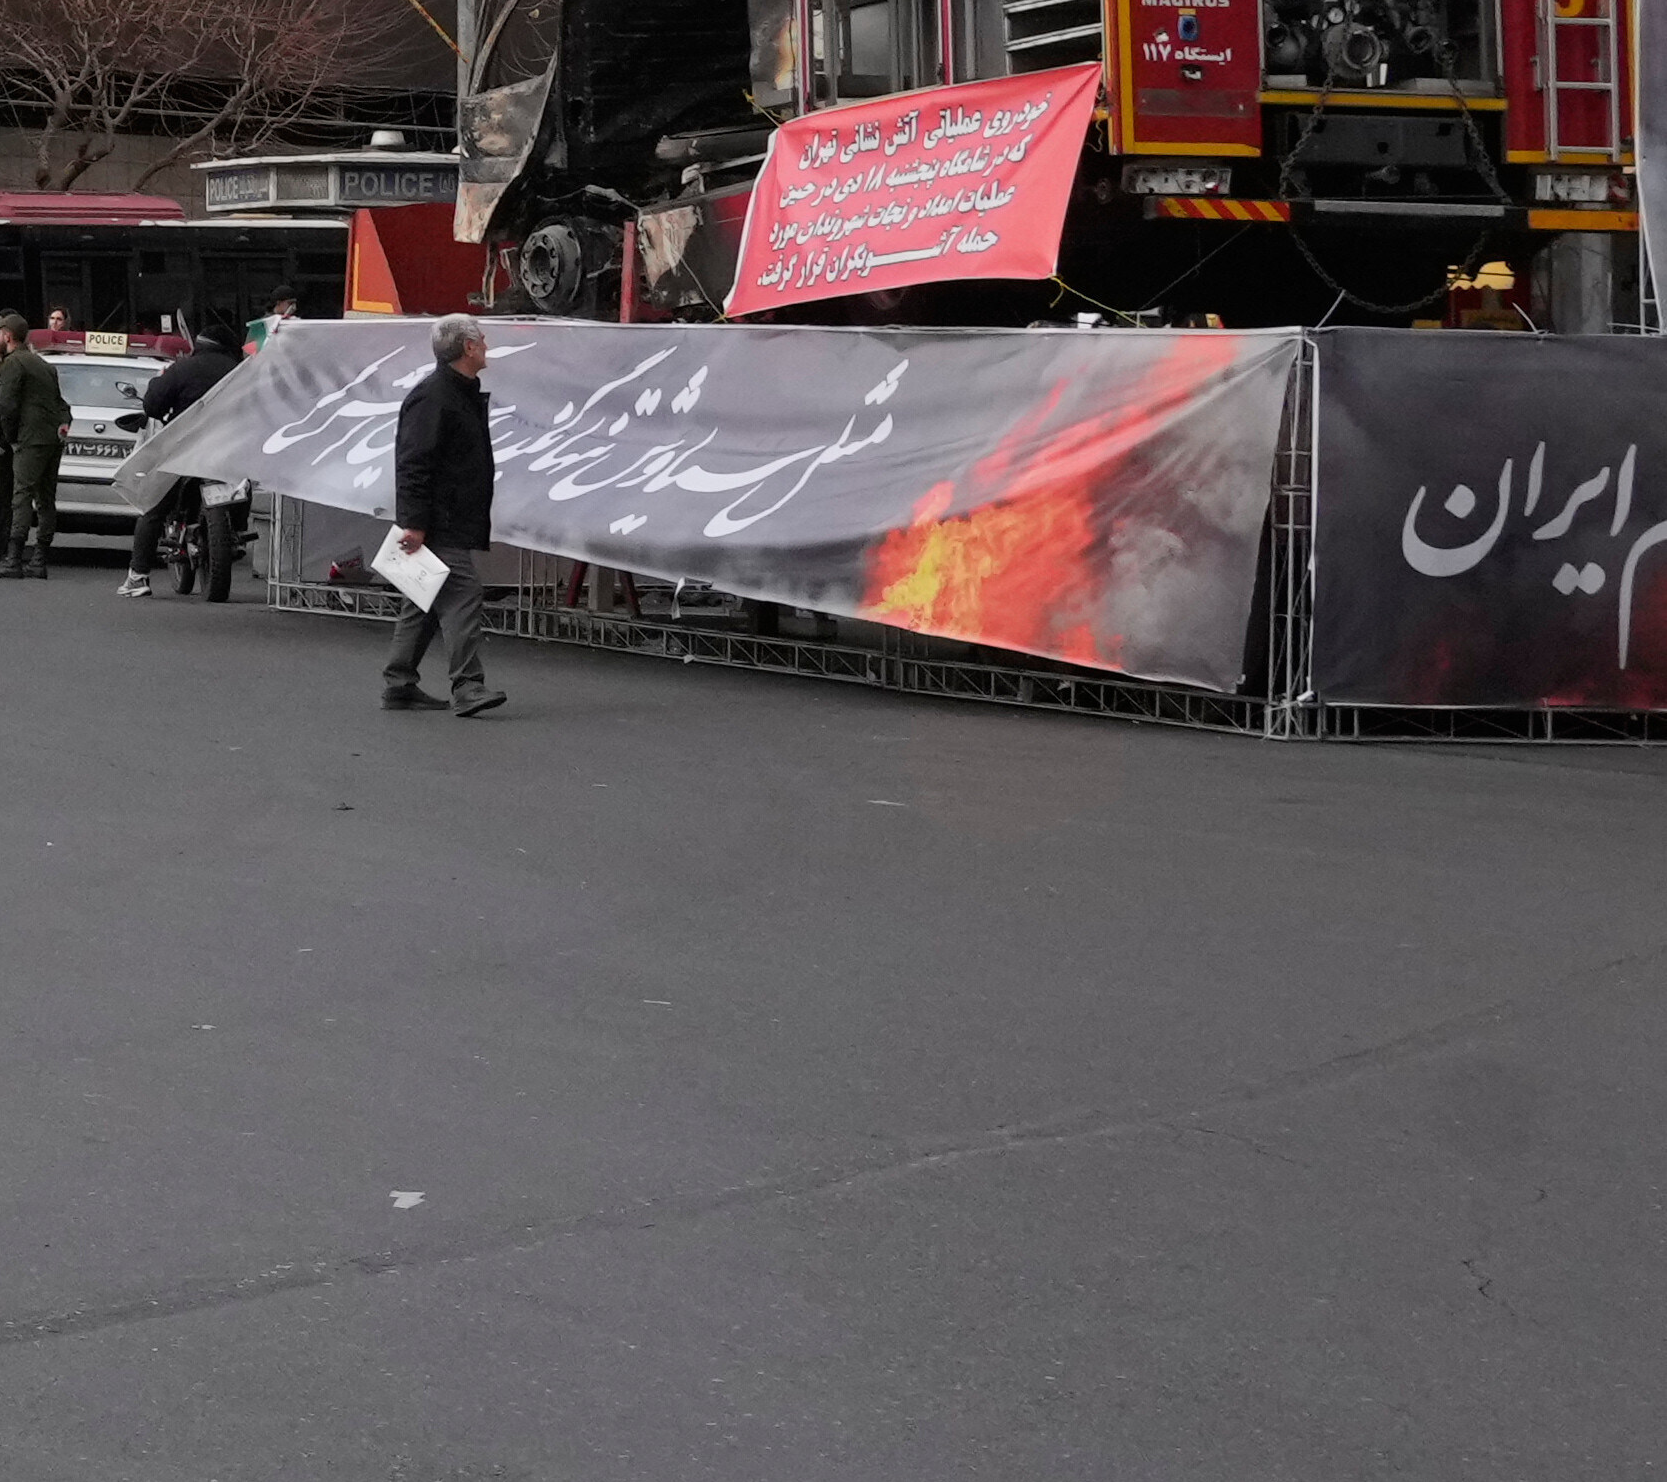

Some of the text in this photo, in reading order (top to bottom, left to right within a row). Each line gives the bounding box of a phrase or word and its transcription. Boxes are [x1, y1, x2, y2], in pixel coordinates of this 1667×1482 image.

[1142, 43, 1232, 65] ایستگاه ۱۱۷
[798, 92, 1053, 171] خودروی عملیاتی آتش نشانی تهران
[939, 144, 988, 178] شامگاه
[1007, 134, 1032, 162] که
[986, 149, 1007, 177] در
[209, 175, 240, 201] POLICE
[344, 171, 435, 197] POLICE
[833, 174, 863, 203] دی
[863, 163, 884, 192] ۱۸
[779, 181, 815, 209] حین
[811, 178, 836, 206] در
[768, 178, 1016, 250] عملیات امداد و نجات شهروندان مورد
[956, 226, 999, 254] حمله
[795, 245, 830, 288] قرار
[87, 333, 124, 346] POLICE
[1400, 440, 1637, 596] ایران
